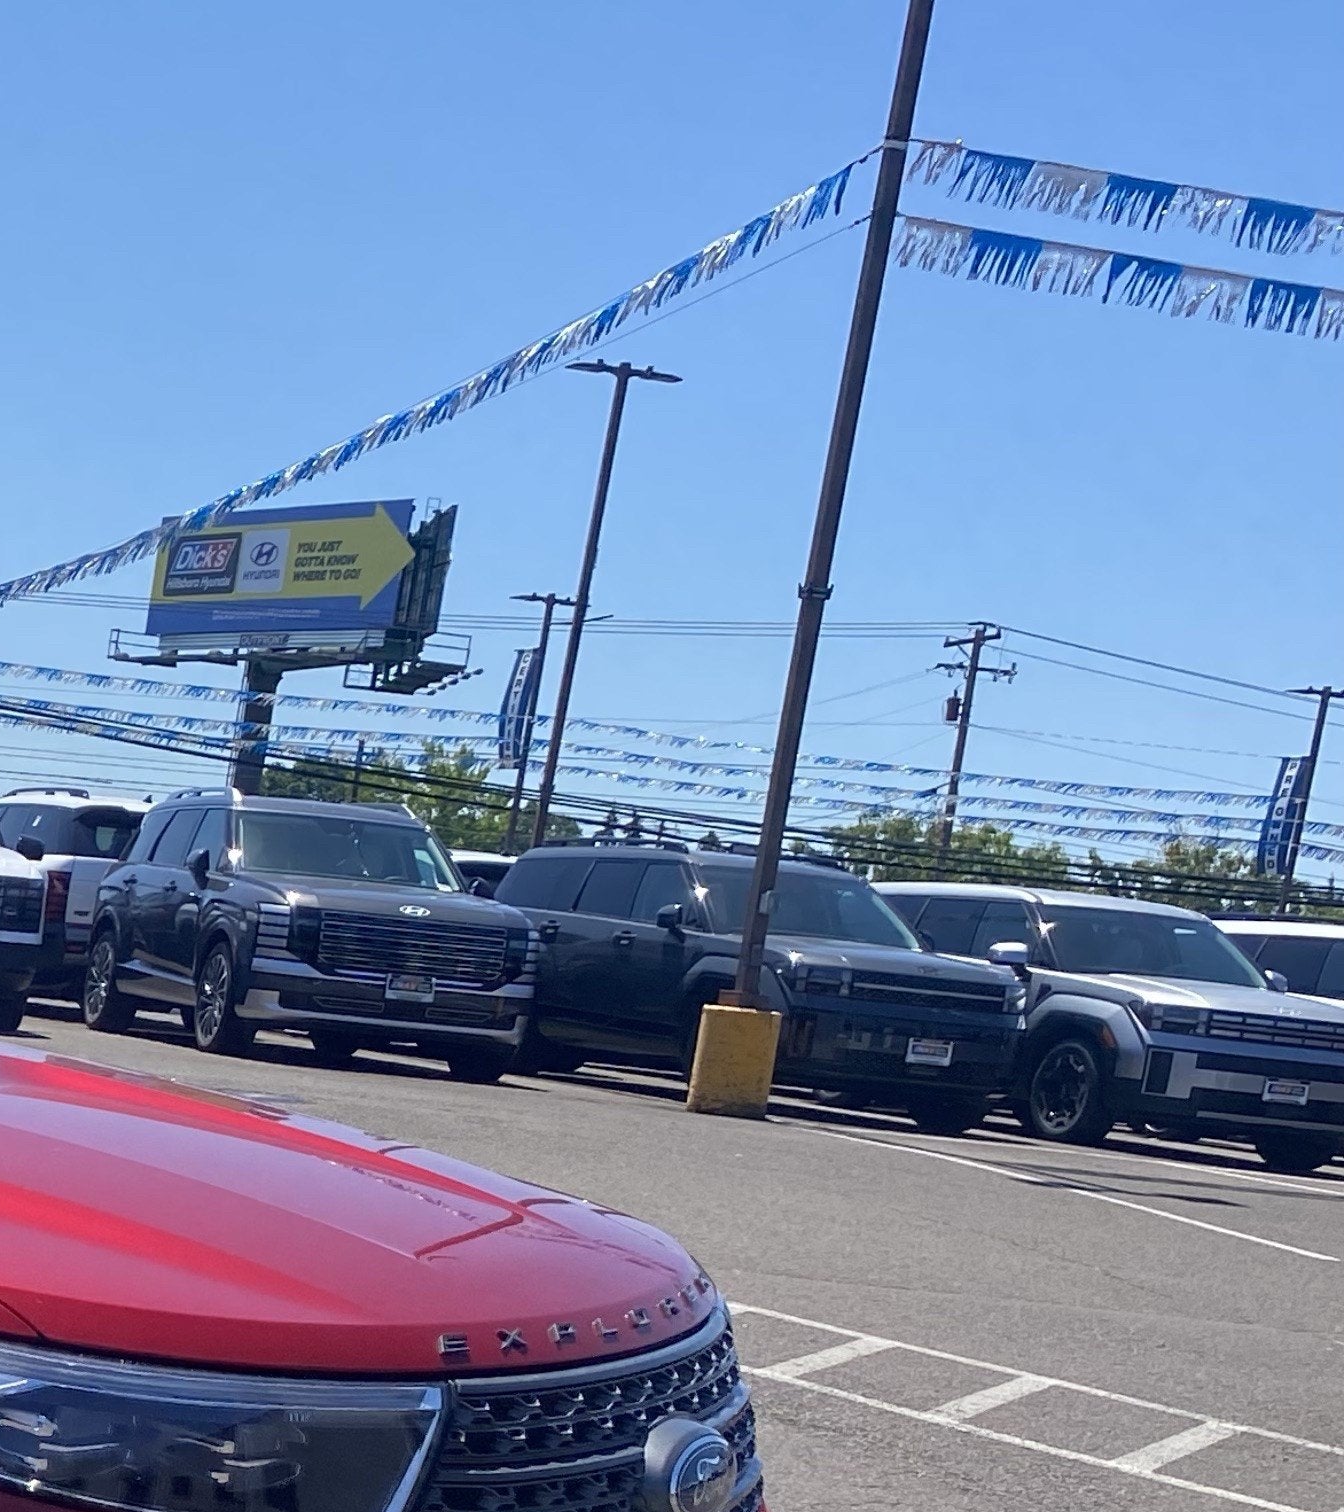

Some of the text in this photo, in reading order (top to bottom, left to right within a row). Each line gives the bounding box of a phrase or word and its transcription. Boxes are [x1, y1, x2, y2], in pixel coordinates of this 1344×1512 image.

[297, 541, 343, 554] YOU JUST
[175, 544, 228, 569] Dick's
[295, 554, 359, 568] GOTTA KNOW
[293, 570, 327, 582] WHERE
[329, 569, 342, 581] TO
